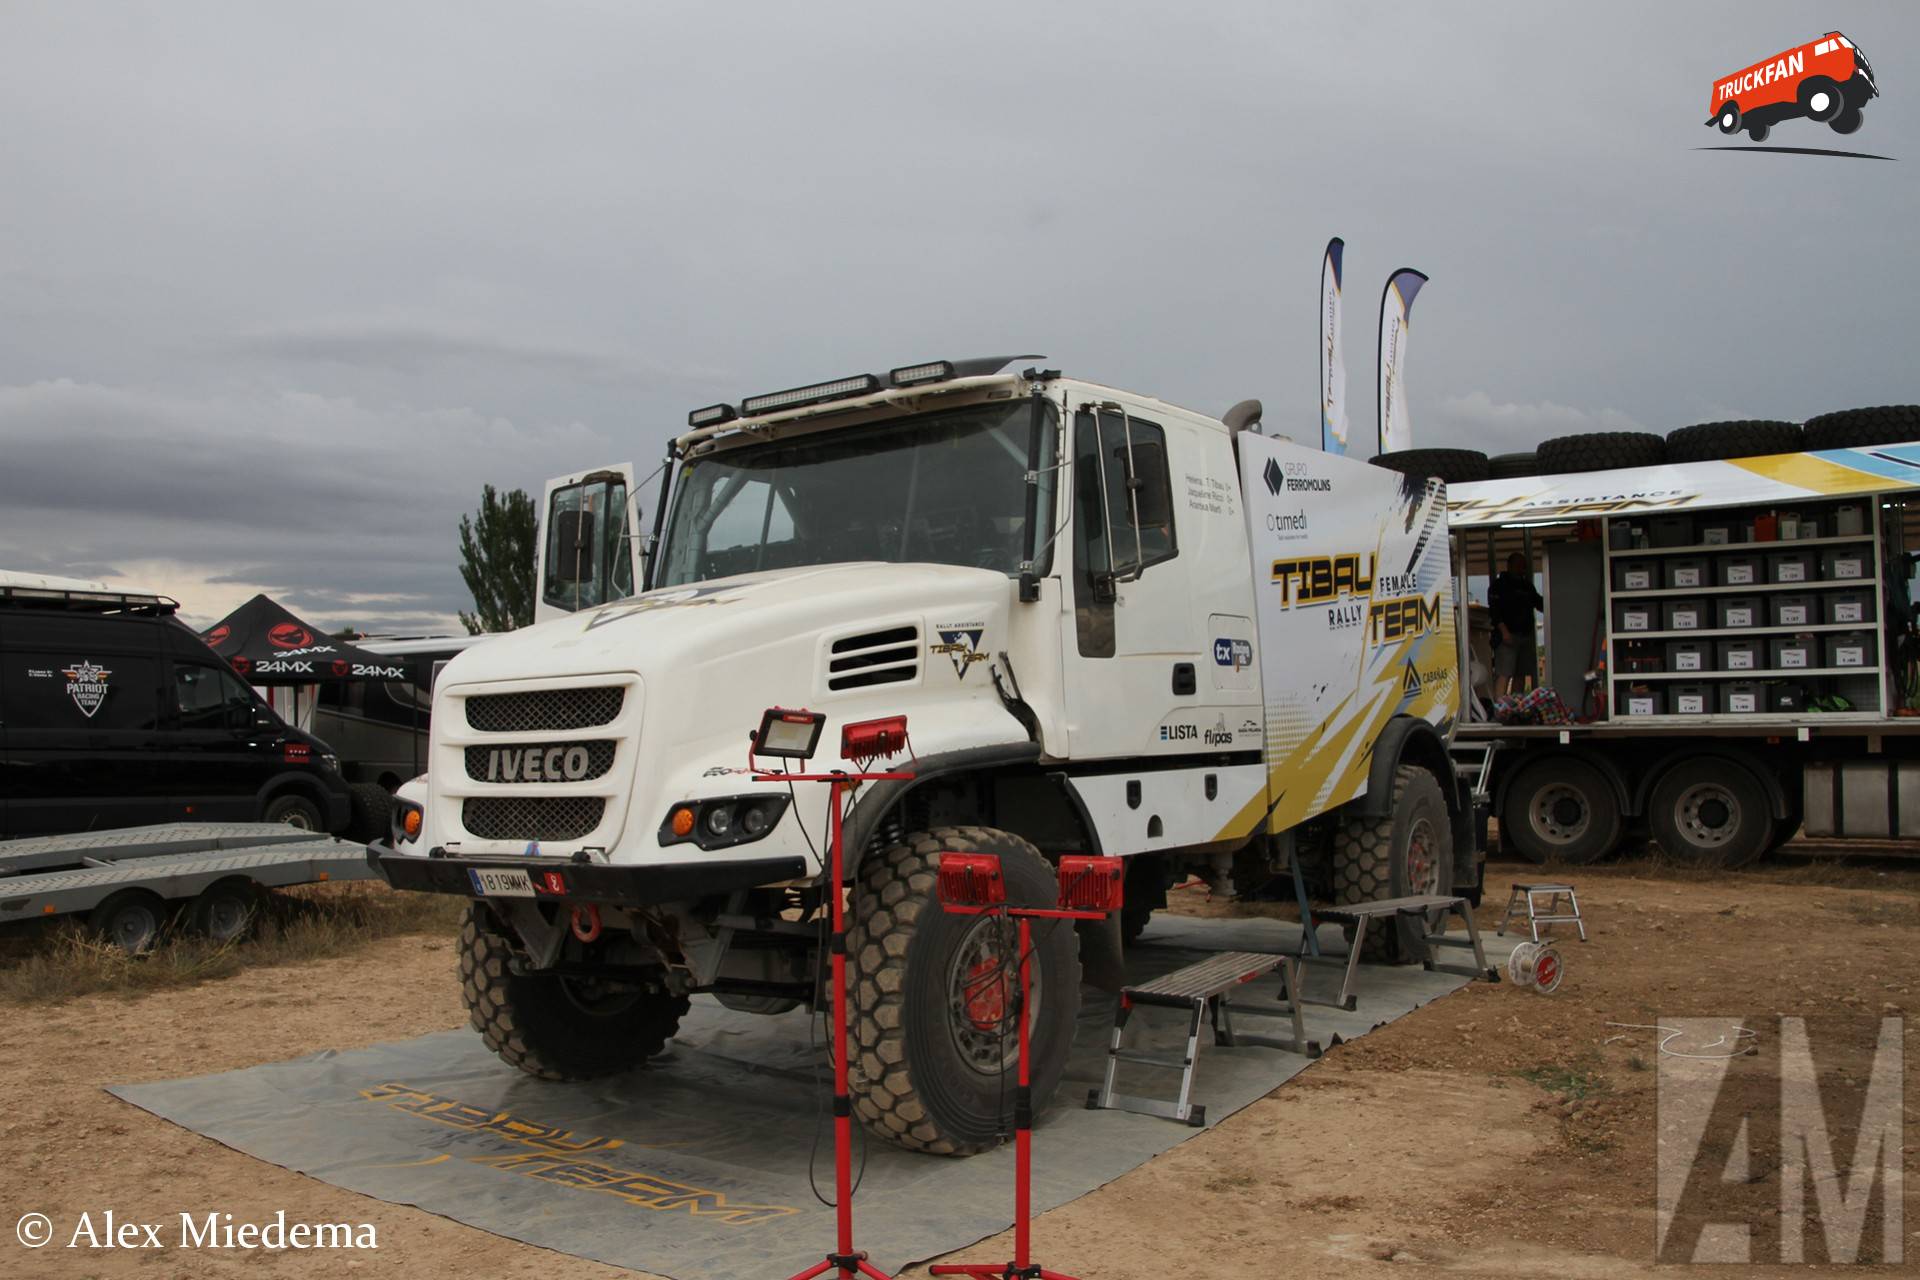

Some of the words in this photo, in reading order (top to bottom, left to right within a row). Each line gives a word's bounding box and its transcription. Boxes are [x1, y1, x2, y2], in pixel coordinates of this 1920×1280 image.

[1285, 462, 1307, 476] GRUPO
[1287, 479, 1331, 492] FERROMOLINS
[1523, 489, 1682, 506] ASSISTANCE
[1271, 552, 1376, 610] TIBAU
[1380, 573, 1417, 593] FEMALE
[1328, 605, 1362, 627] RALLY
[1370, 592, 1440, 647] TEAM
[273, 646, 338, 658] 24MX
[255, 660, 314, 673] 24MX
[352, 664, 404, 679] 24MX
[66, 683, 108, 694] PATRIOT
[1169, 725, 1198, 740] LISTA
[488, 746, 589, 780] IVECO
